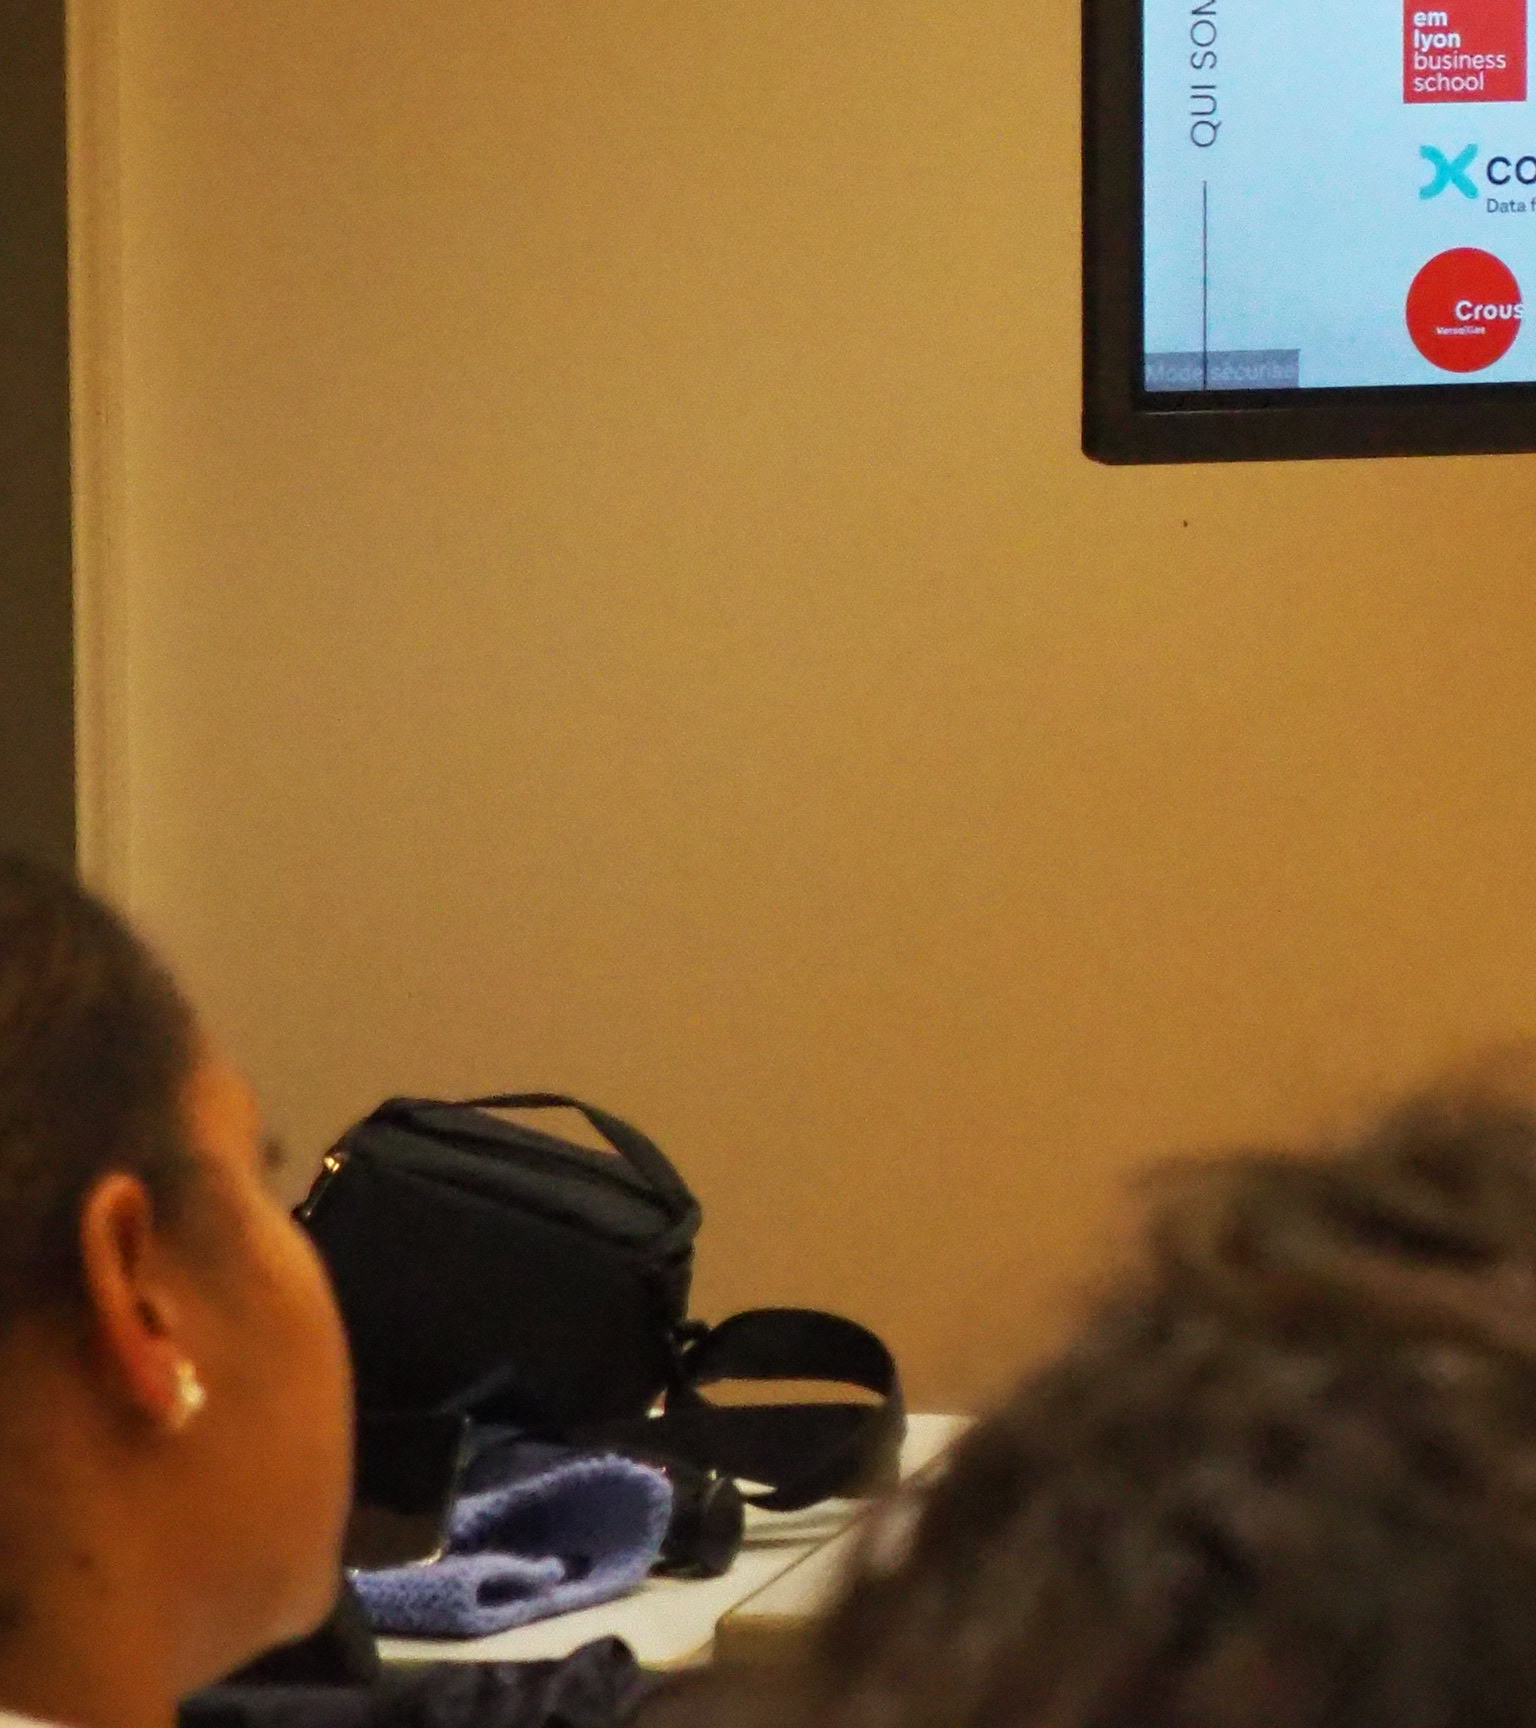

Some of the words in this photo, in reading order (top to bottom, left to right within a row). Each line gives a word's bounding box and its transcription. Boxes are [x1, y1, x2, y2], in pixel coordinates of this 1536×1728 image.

[1413, 10, 1449, 27] em
[1413, 28, 1462, 52] lyon
[1413, 50, 1507, 70] business
[1413, 71, 1485, 92] school
[1190, 84, 1222, 149] QUI
[1486, 198, 1527, 214] Data
[1455, 300, 1526, 321] Crous
